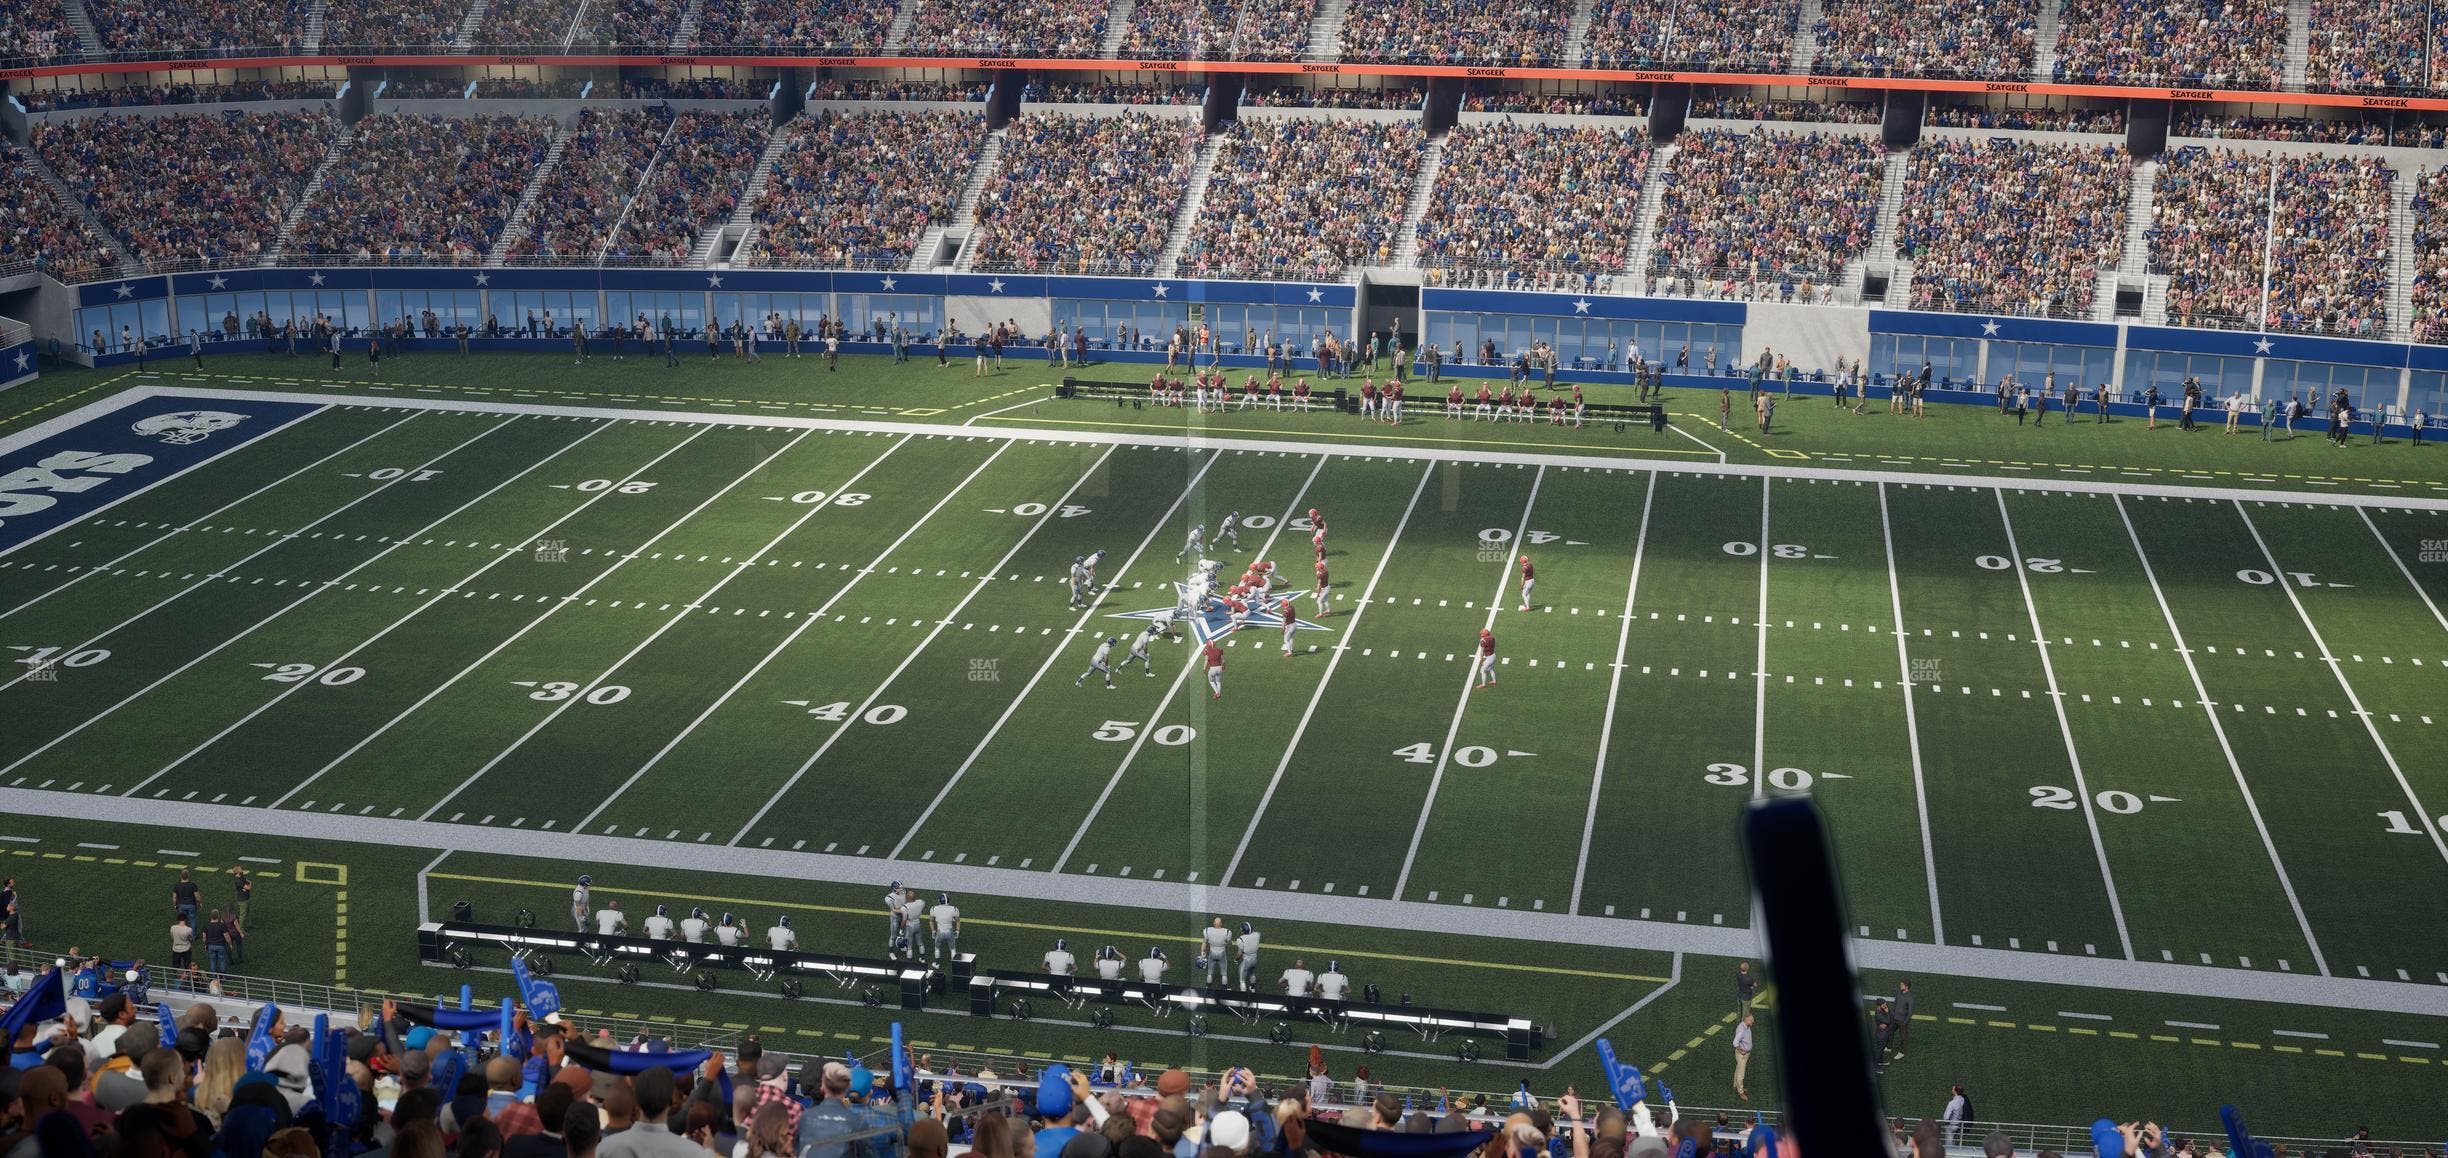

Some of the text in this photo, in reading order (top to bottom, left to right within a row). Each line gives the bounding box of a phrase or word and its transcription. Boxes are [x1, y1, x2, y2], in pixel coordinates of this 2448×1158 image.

[168, 61, 208, 71] SEATGEEK
[337, 57, 375, 66] SEATGEEK
[660, 57, 697, 66] SEATGEEK
[819, 57, 857, 66] SEATGEEK
[1140, 62, 1177, 70] SEATGEEK
[1467, 69, 1505, 77] SEATGEEK
[1636, 73, 1674, 81] SEATGEEK
[1808, 78, 1848, 87] SEATGEEK
[1986, 84, 2028, 92] SEATGEEK
[2171, 91, 2213, 99] SEATGEEK
[2364, 98, 2409, 107] SEATGEEK
[369, 468, 444, 481] 10
[577, 479, 658, 493] 20
[792, 491, 871, 506] 30
[1013, 503, 1091, 517] 40
[1242, 516, 1319, 531] 50
[1478, 528, 1561, 544] 40
[1723, 542, 1807, 558] 30
[1976, 556, 2064, 572] 20
[2236, 570, 2321, 586] 10
[14, 647, 111, 667] 10
[261, 664, 366, 685] 20
[529, 682, 631, 704] 30
[808, 702, 907, 724] 40
[1092, 720, 1197, 746] 50
[1393, 743, 1498, 767] 40
[1704, 763, 1813, 790] 30
[2029, 786, 2143, 814] 20
[2377, 811, 2448, 834] 1
